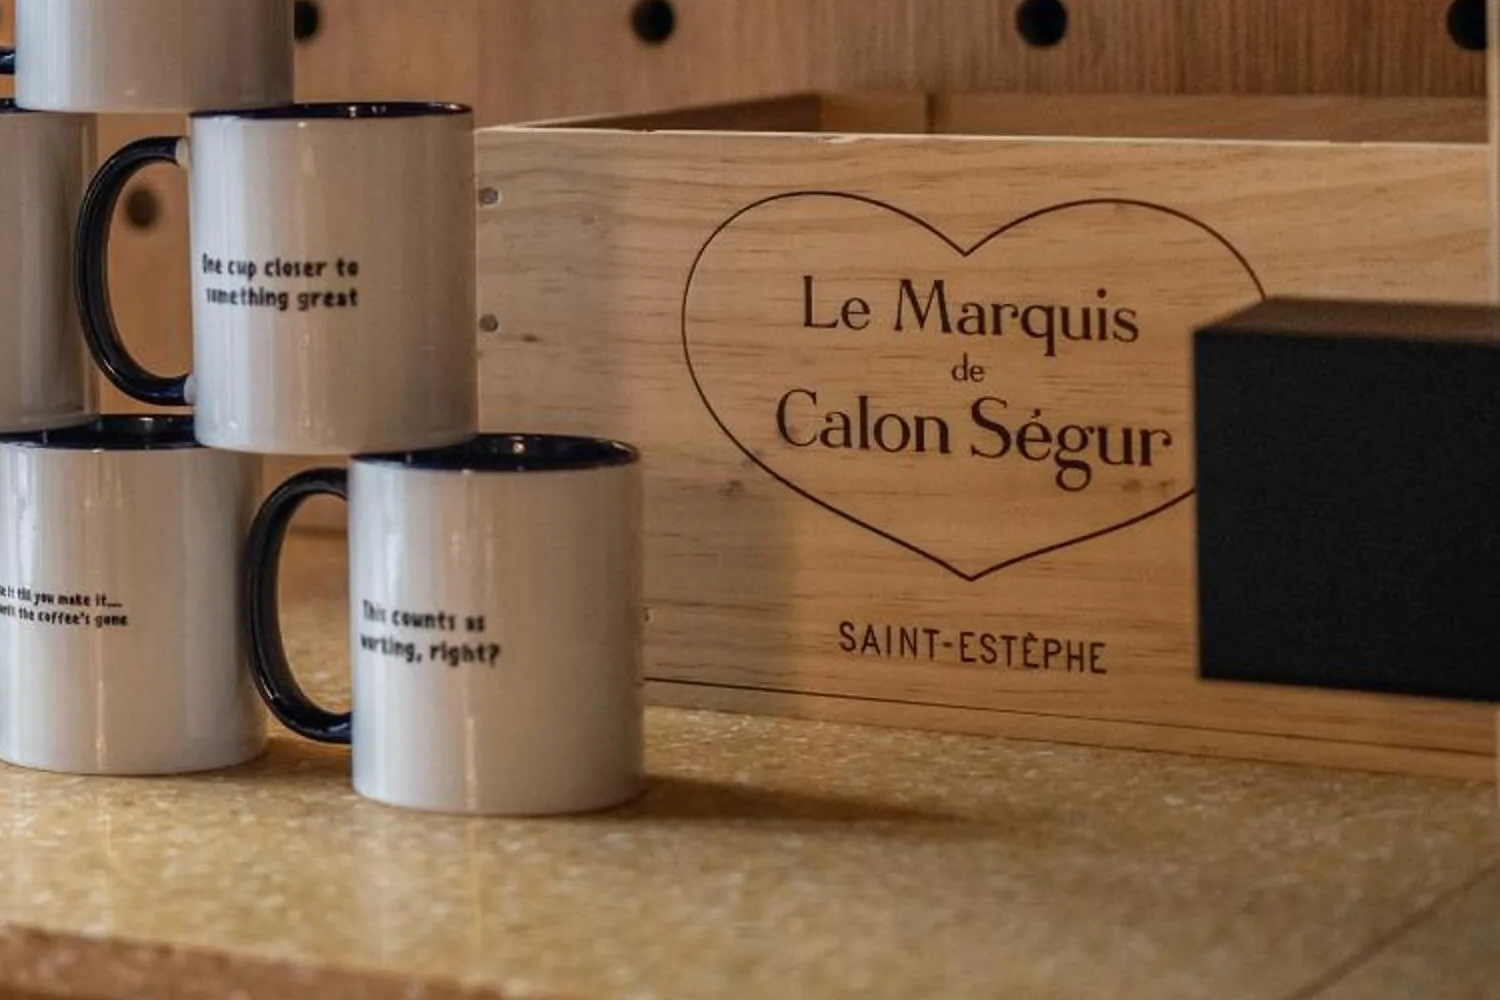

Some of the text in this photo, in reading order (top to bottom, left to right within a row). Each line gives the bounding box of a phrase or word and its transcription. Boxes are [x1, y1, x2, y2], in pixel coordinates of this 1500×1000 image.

[228, 260, 256, 281] cup
[264, 257, 327, 277] closer
[336, 257, 359, 277] to
[297, 287, 358, 311] great
[802, 275, 1140, 357] Le Marquis
[950, 353, 986, 383] de
[776, 388, 1173, 492] Calon Ségur
[34, 592, 54, 606] you
[57, 593, 90, 607] make
[18, 607, 34, 621] the
[37, 611, 91, 626] coffee's
[95, 615, 128, 629] gone
[392, 609, 456, 631] counts
[465, 614, 486, 632] as
[430, 641, 501, 668] right?
[838, 621, 1108, 675] SAINT-ESTÈPHE
